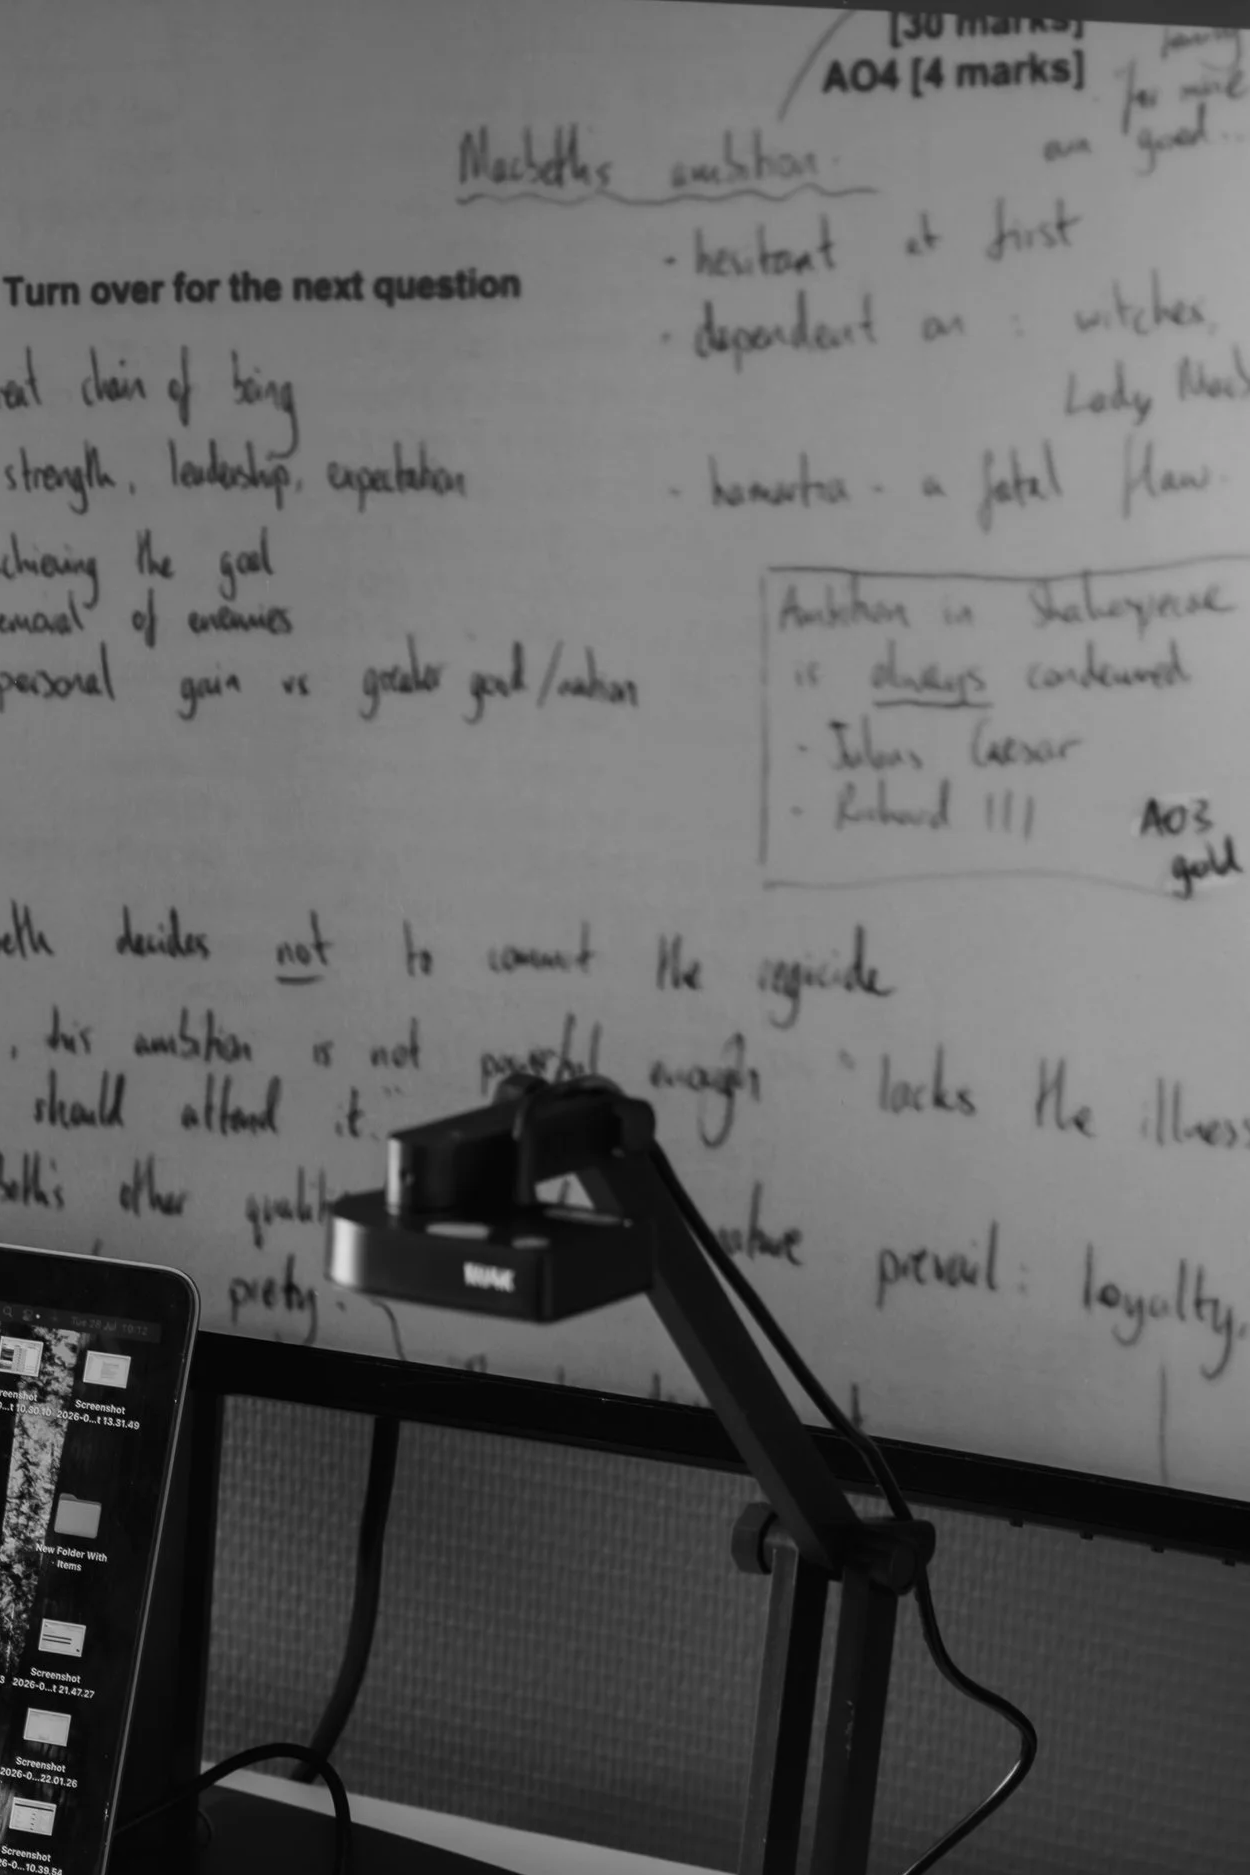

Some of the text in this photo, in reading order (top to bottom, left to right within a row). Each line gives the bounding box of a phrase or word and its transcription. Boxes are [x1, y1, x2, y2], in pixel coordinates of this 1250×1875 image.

[823, 49, 1086, 99] AO4 [4 marks]
[986, 196, 1079, 260] first
[3, 267, 522, 309] Turn over for the next question
[326, 441, 468, 513] expectation
[137, 529, 174, 581] the
[220, 526, 274, 601] goal
[115, 904, 211, 962] decides
[276, 908, 332, 968] not
[370, 1016, 420, 1070] not
[34, 1069, 126, 1130] should
[180, 1073, 282, 1138] attend
[75, 1399, 126, 1415] Screenshot
[56, 1546, 85, 1559] Folder
[87, 1551, 108, 1562] With
[56, 1560, 82, 1572] Items
[30, 1666, 81, 1683] Screenshot
[15, 1756, 66, 1773] Screenshot
[1, 1845, 51, 1862] Screenshot
